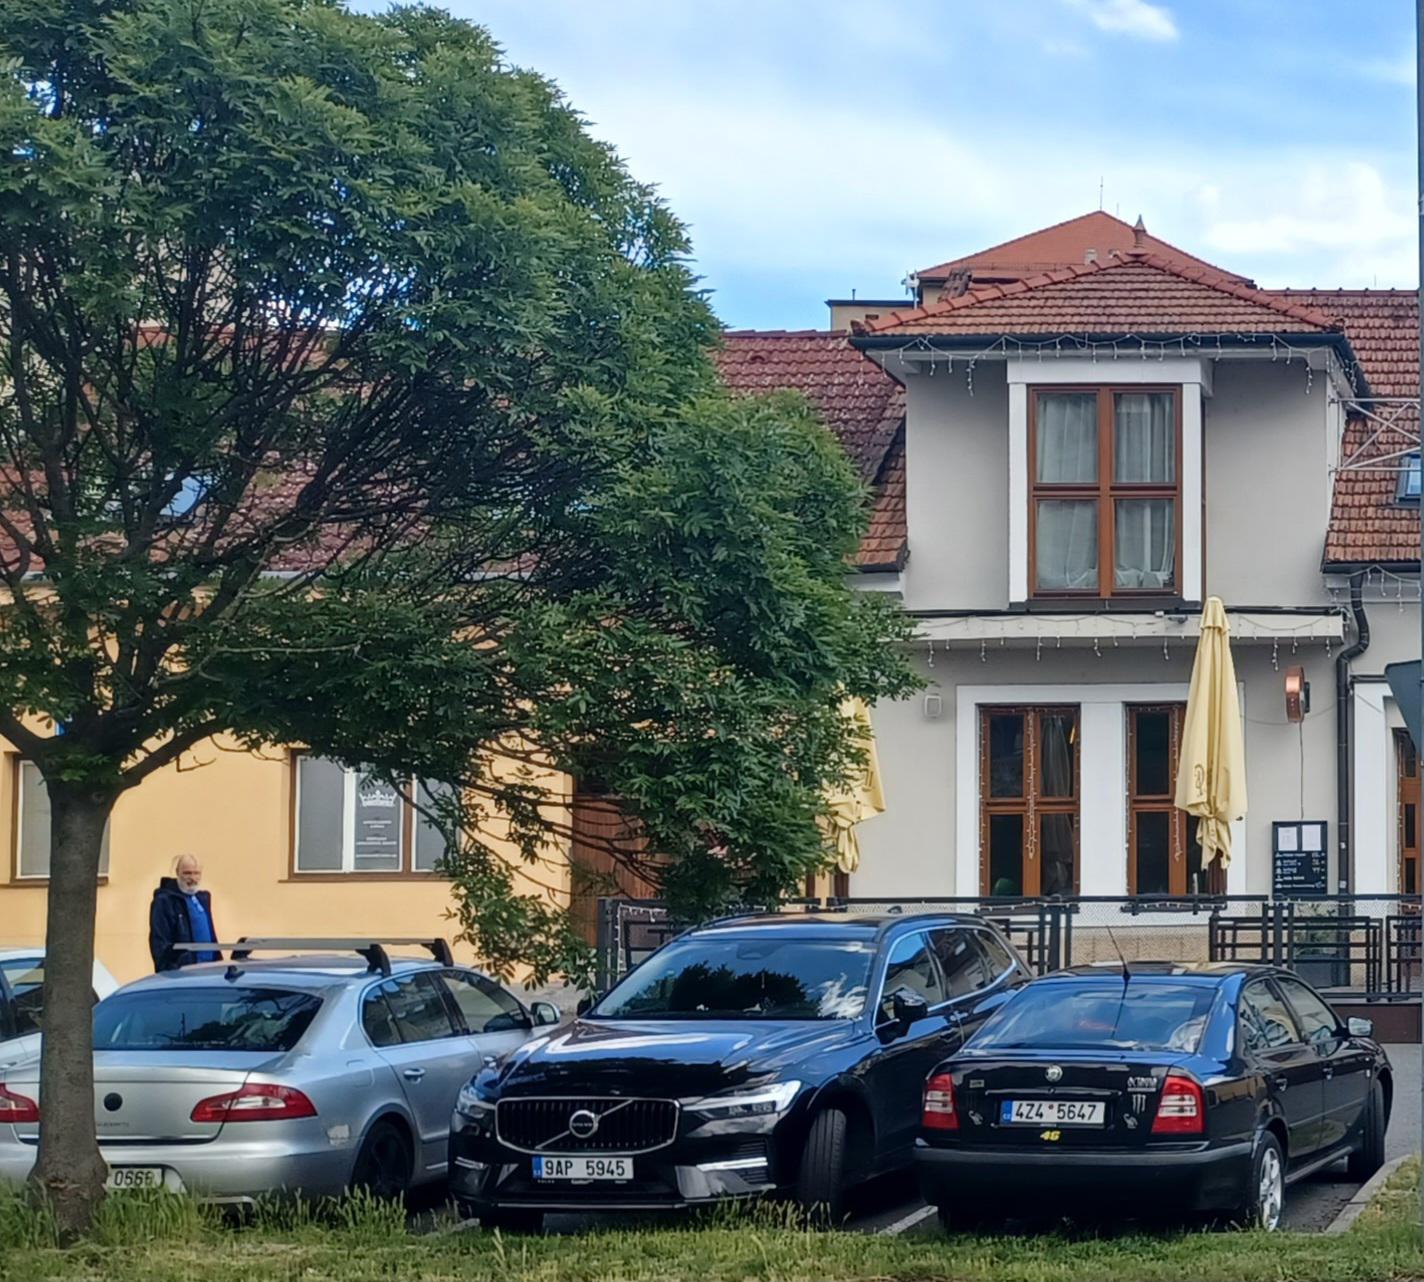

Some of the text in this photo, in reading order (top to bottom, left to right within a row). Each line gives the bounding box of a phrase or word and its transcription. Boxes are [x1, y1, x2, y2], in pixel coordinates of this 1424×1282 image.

[1015, 1103, 1044, 1120] 4Z4
[1056, 1103, 1097, 1120] 5647
[545, 1160, 573, 1177] 9AP
[585, 1160, 625, 1177] 5945
